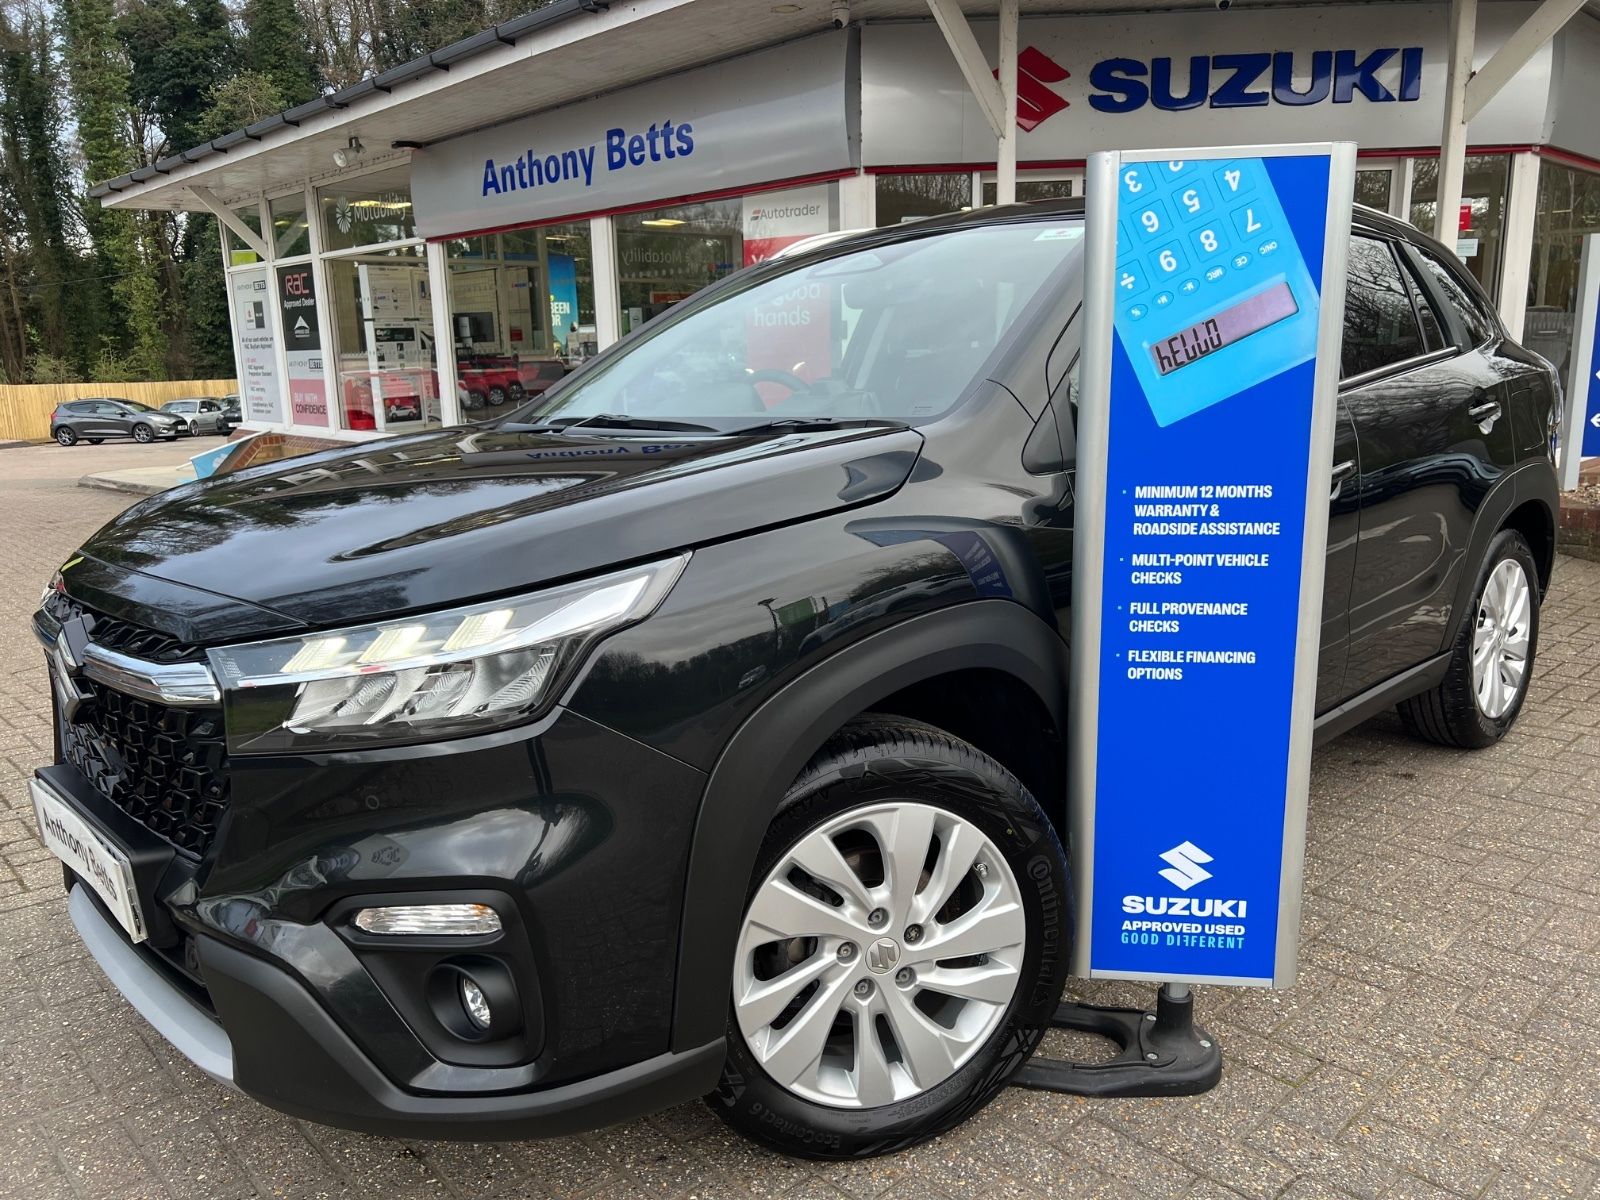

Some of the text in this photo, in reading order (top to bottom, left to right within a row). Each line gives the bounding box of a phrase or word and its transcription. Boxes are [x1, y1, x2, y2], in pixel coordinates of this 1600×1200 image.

[1088, 47, 1423, 113] SUZUKI
[482, 119, 694, 197] Anthony Betts
[1124, 170, 1142, 192] 3
[1224, 169, 1241, 191] 4
[1182, 189, 1200, 213] 5
[760, 204, 821, 220] Autotrader
[1141, 210, 1159, 232] 6
[1246, 208, 1262, 233] 7
[1200, 230, 1218, 252] 8
[1159, 250, 1177, 272] 9
[1235, 255, 1248, 267] CE
[754, 305, 811, 327] hands
[295, 403, 326, 415] CONFIDENCE
[1135, 485, 1272, 498] MINIMUM 12 MONTHS
[1134, 504, 1220, 517] WARRANTY &
[1133, 522, 1280, 535] ROADSIDE ASSISTANCE
[1132, 554, 1269, 567] MULTI-POINT VEHICLE
[1131, 572, 1182, 584] CHECKS
[1129, 602, 1248, 615] FULL PROVENANCE
[1129, 620, 1179, 632] CHECKS
[1128, 650, 1256, 664] FLEXIBLE FINANCING
[1127, 667, 1182, 680] OPTIONS
[43, 807, 117, 901] Anthony Betts
[1122, 895, 1247, 918] SUZUKI
[1121, 920, 1245, 936] APPROVED USED
[1121, 932, 1245, 949] GOOD DIFFERENT
